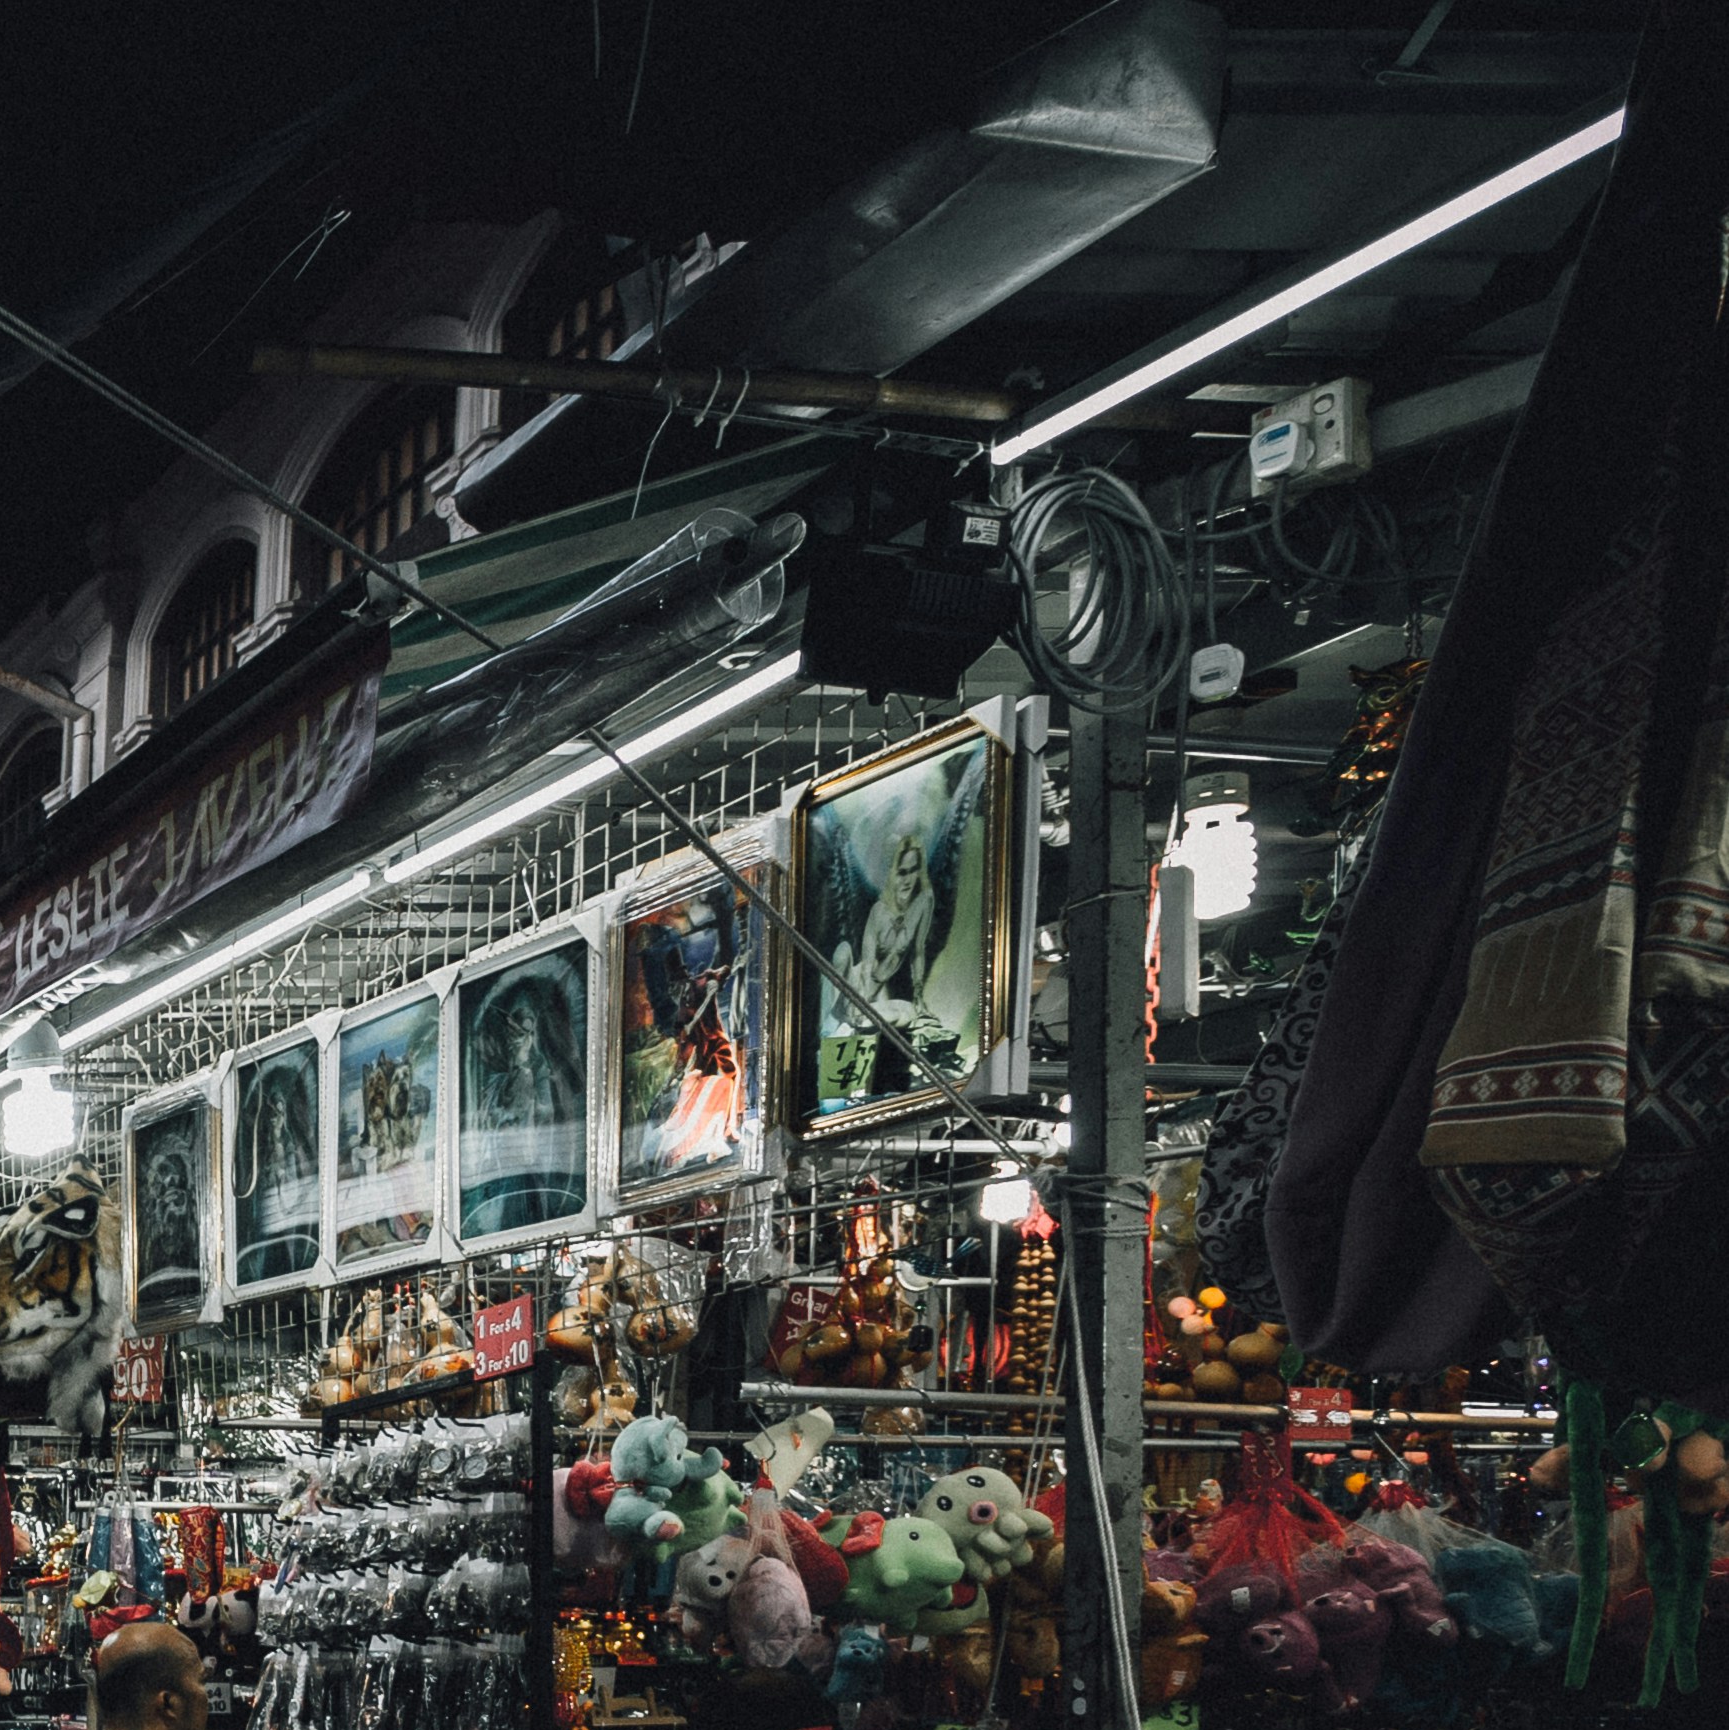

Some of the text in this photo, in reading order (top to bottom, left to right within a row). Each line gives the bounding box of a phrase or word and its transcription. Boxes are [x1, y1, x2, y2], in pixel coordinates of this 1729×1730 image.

[14, 842, 130, 987] LESLIE
[476, 1306, 523, 1340] 1 For $4
[476, 1340, 530, 1377] 3 For $10
